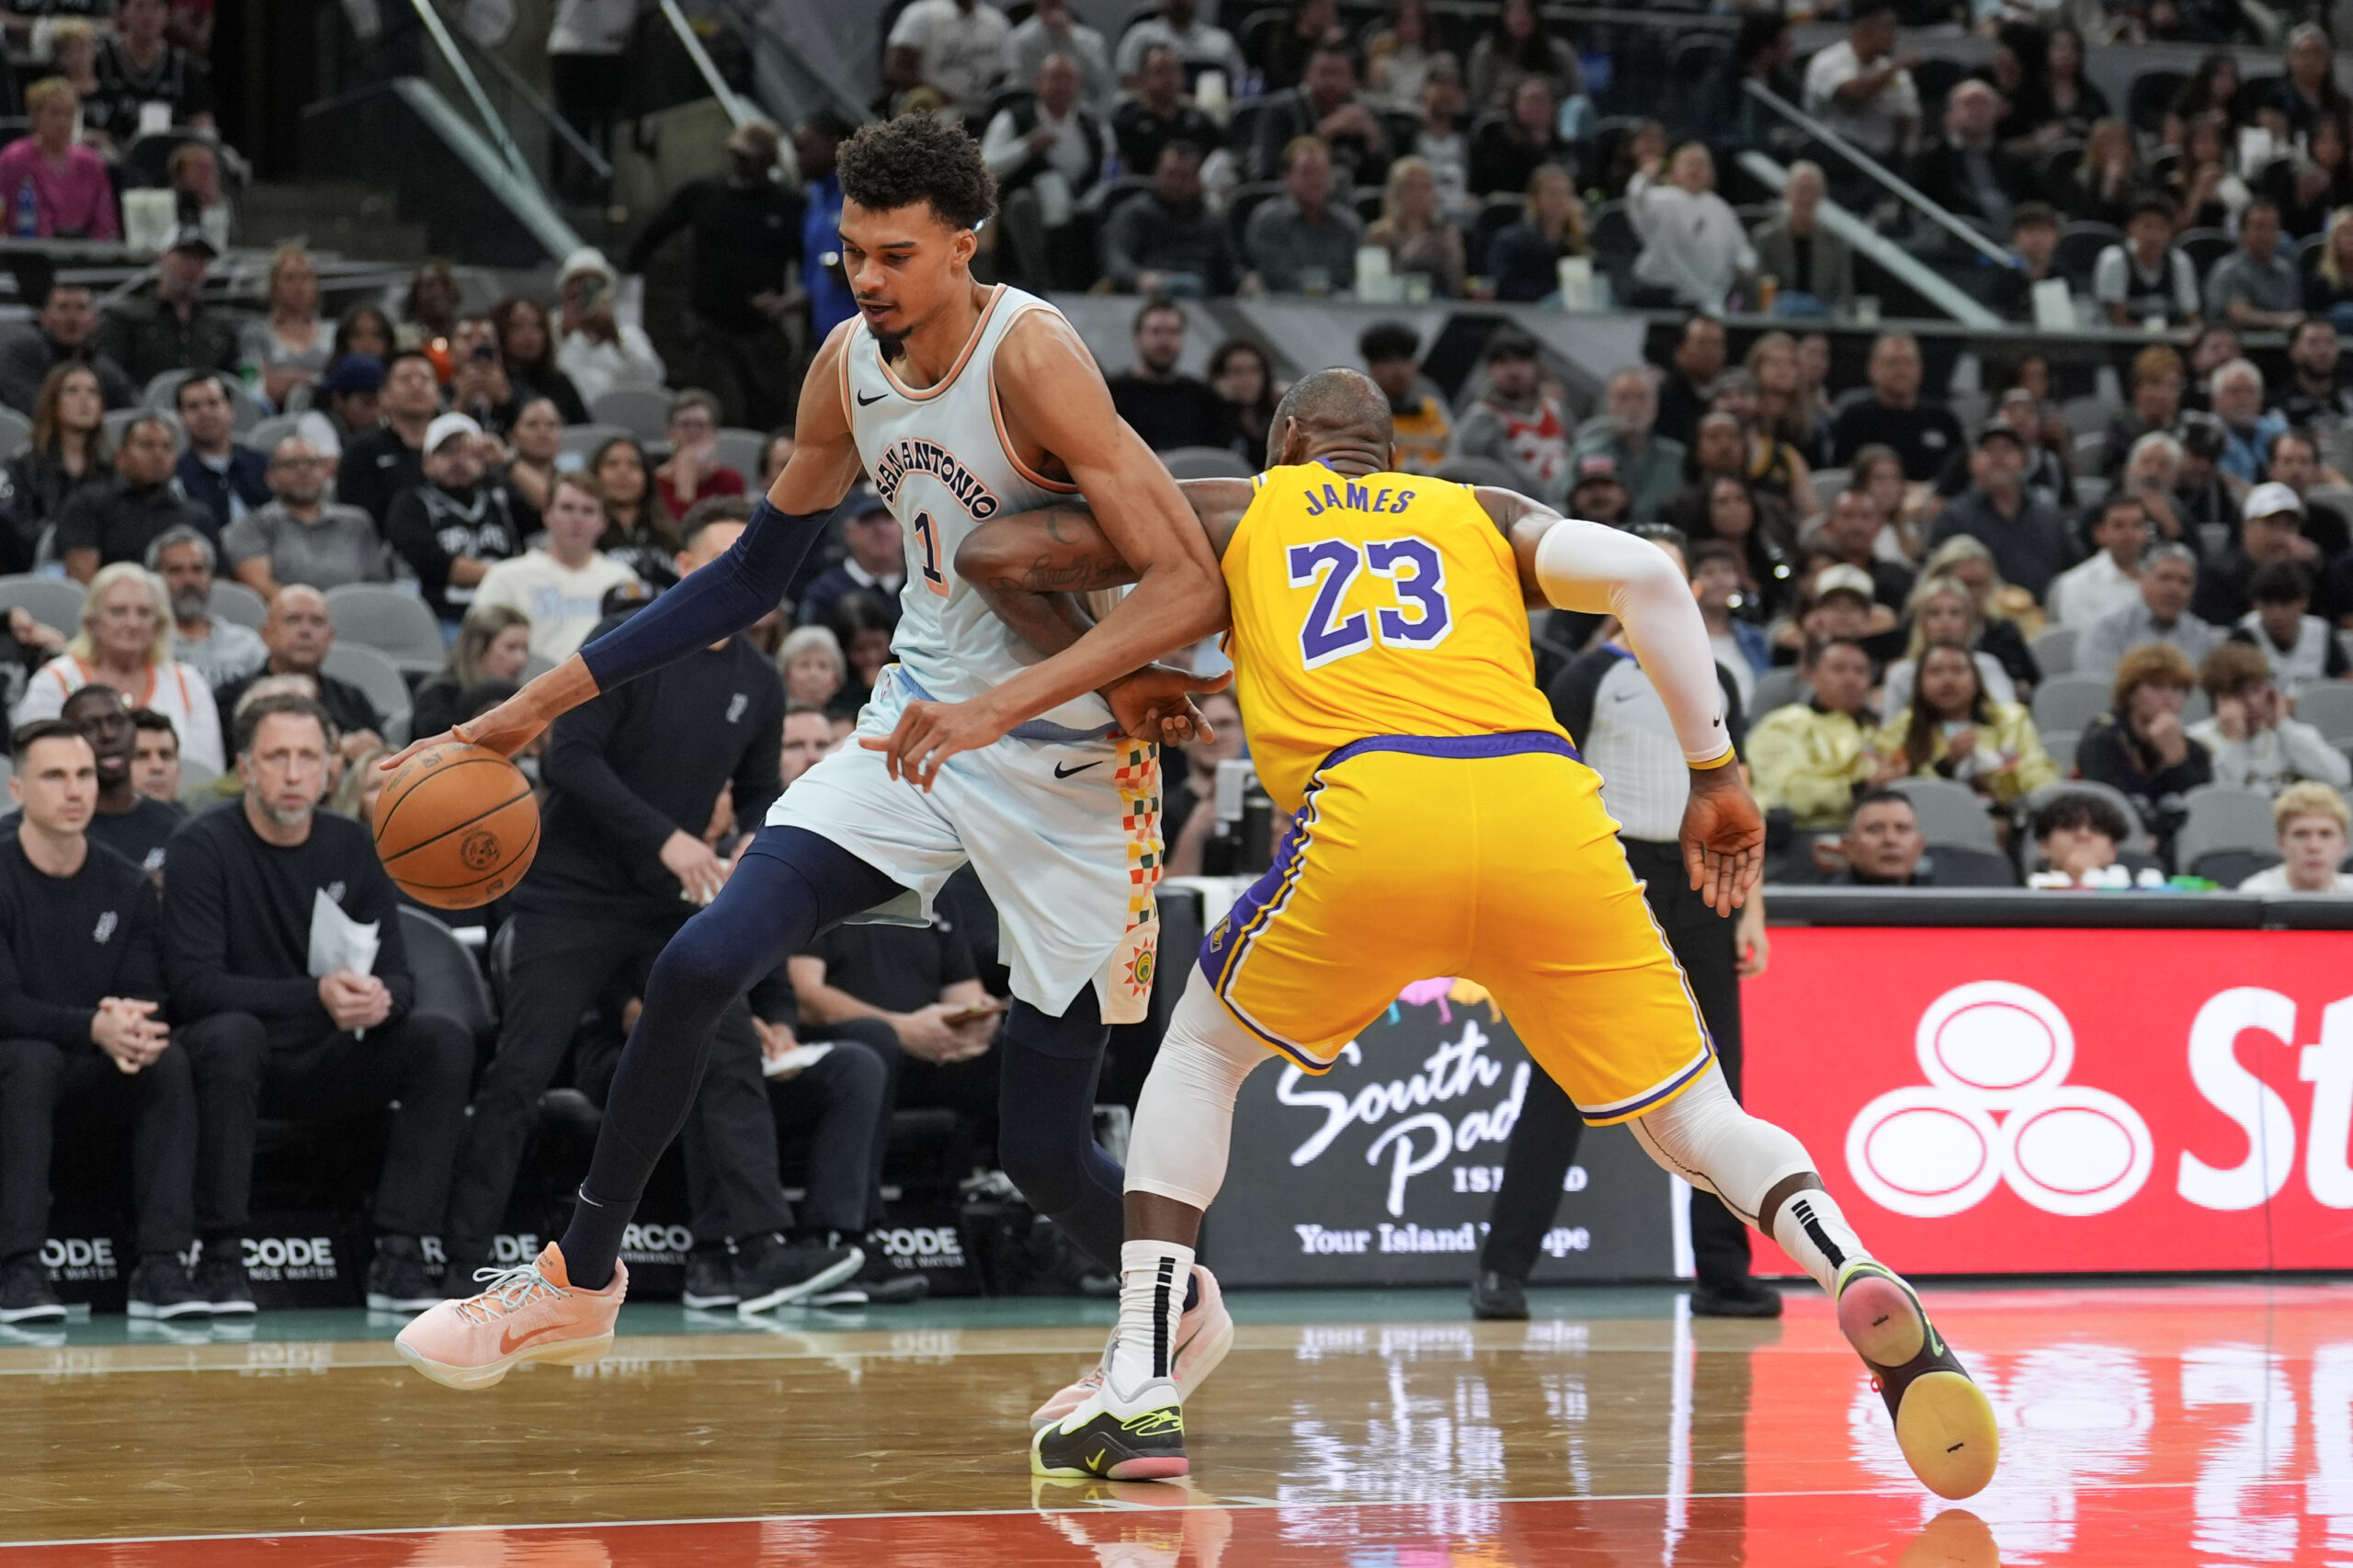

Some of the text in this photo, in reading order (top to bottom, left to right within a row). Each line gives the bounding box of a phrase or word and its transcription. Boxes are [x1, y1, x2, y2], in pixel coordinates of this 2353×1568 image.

[874, 437, 1001, 522] SAN ANTONIO
[1303, 483, 1416, 517] JAMES
[913, 510, 948, 596] 1
[1285, 535, 1454, 672] 23
[1277, 1019, 1502, 1167] South
[1366, 1061, 1531, 1218] Pad
[40, 1238, 117, 1267] ODE
[240, 1237, 336, 1267] CODE
[1295, 1224, 1372, 1255] Your
[1377, 1222, 1476, 1254] Island
